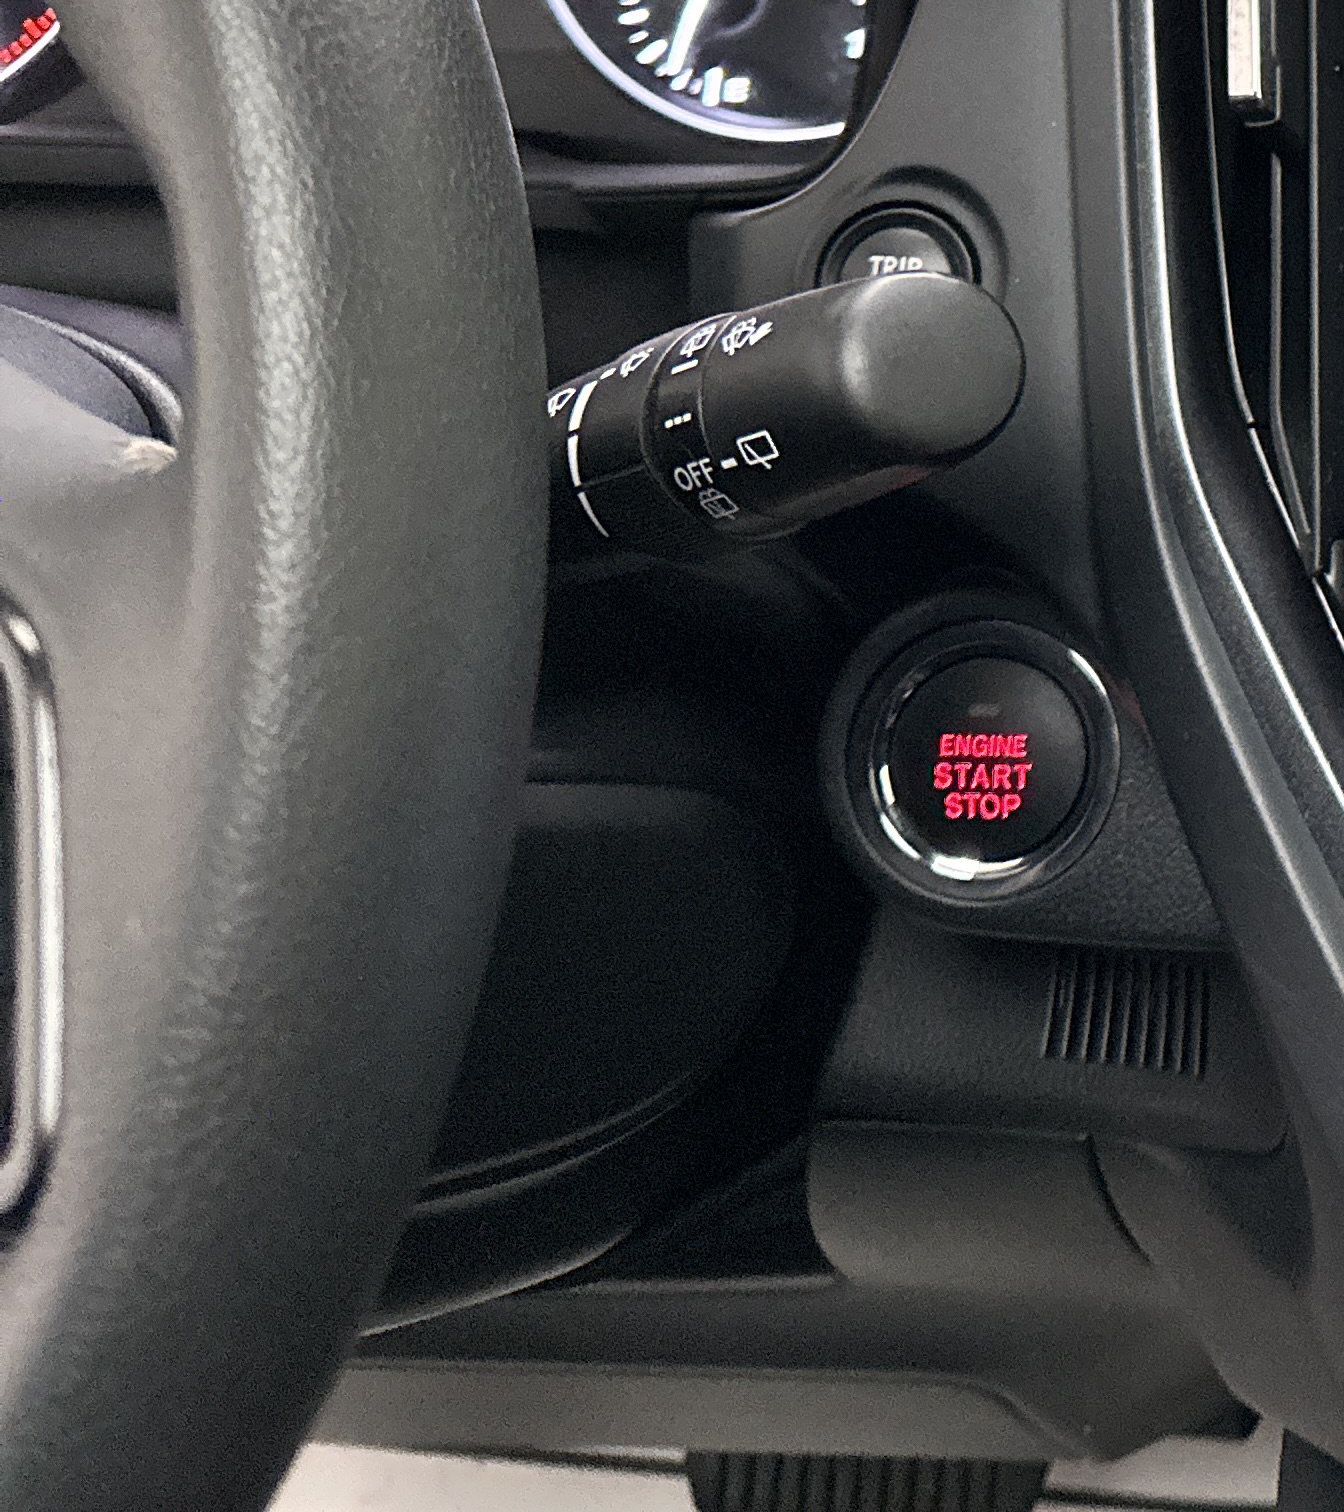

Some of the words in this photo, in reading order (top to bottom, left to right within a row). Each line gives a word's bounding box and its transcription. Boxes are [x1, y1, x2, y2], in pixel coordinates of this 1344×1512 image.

[673, 457, 714, 491] OFF
[939, 733, 1029, 758] ENGINE
[933, 761, 1033, 790] START
[943, 791, 1022, 820] STOP
